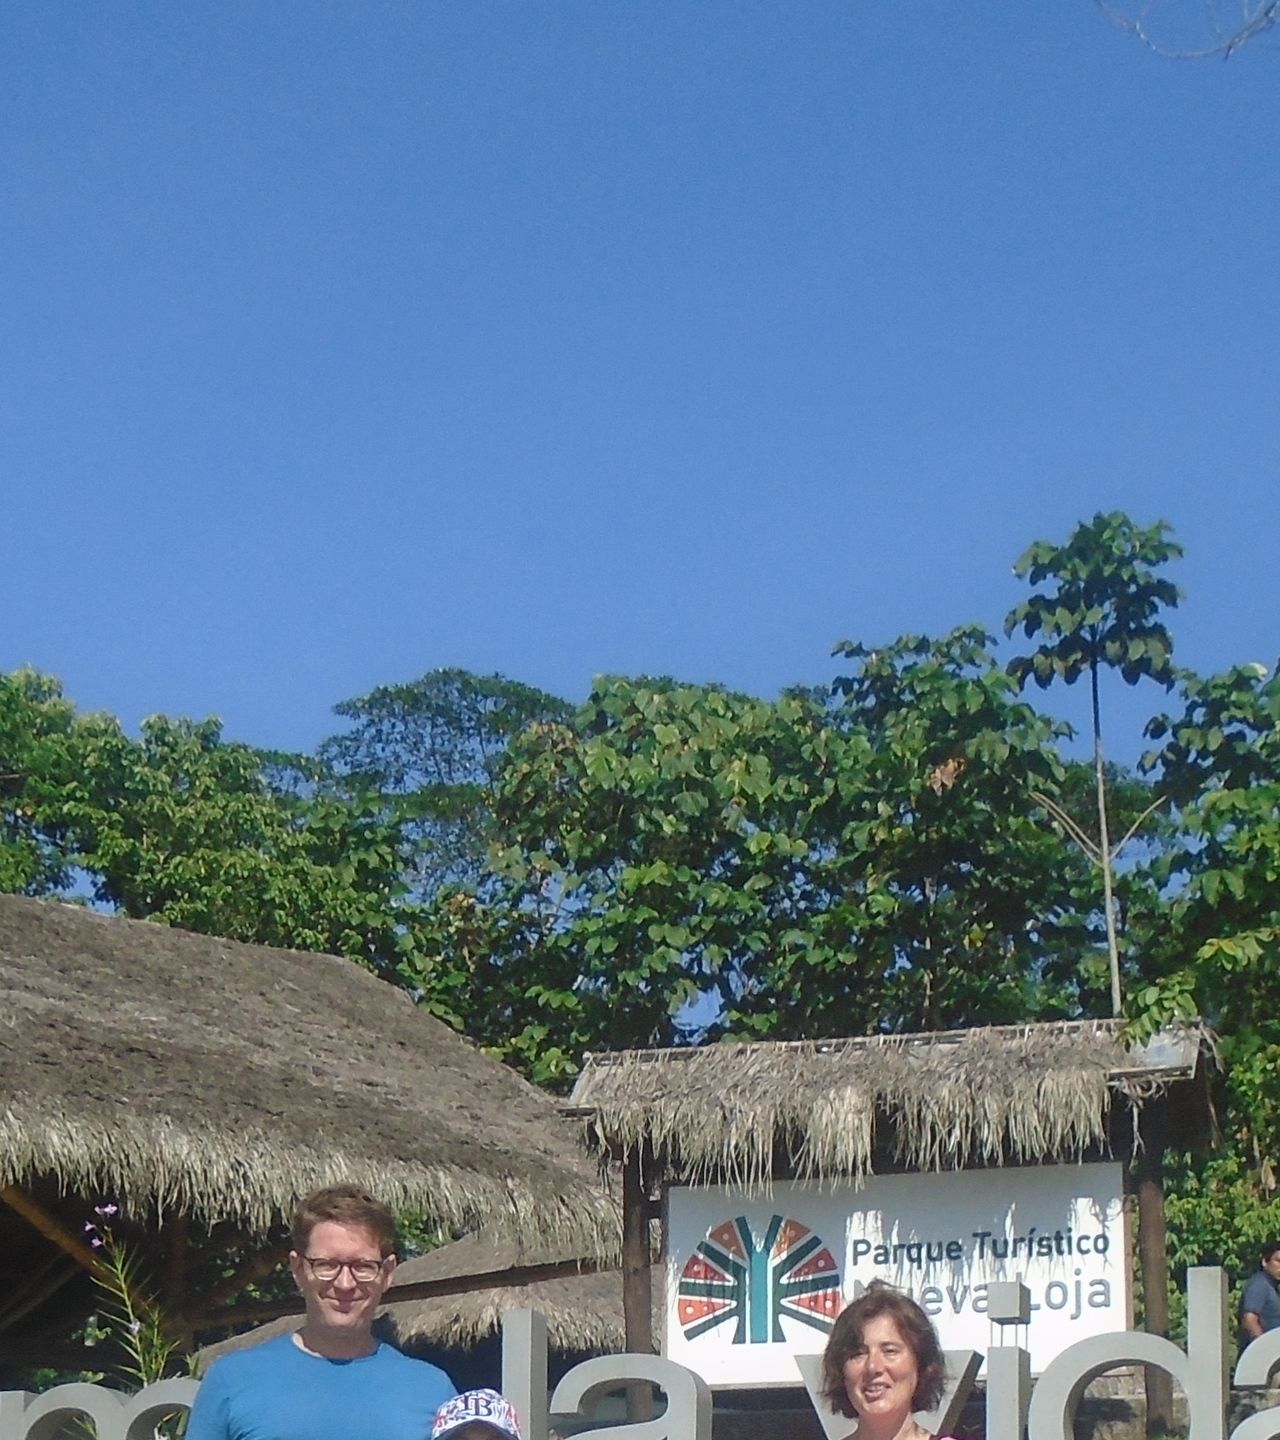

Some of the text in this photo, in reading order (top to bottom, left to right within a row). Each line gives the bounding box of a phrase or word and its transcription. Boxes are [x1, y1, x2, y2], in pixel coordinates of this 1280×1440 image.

[852, 1227, 1111, 1270] Parque Turístico
[853, 1277, 989, 1316] eva
